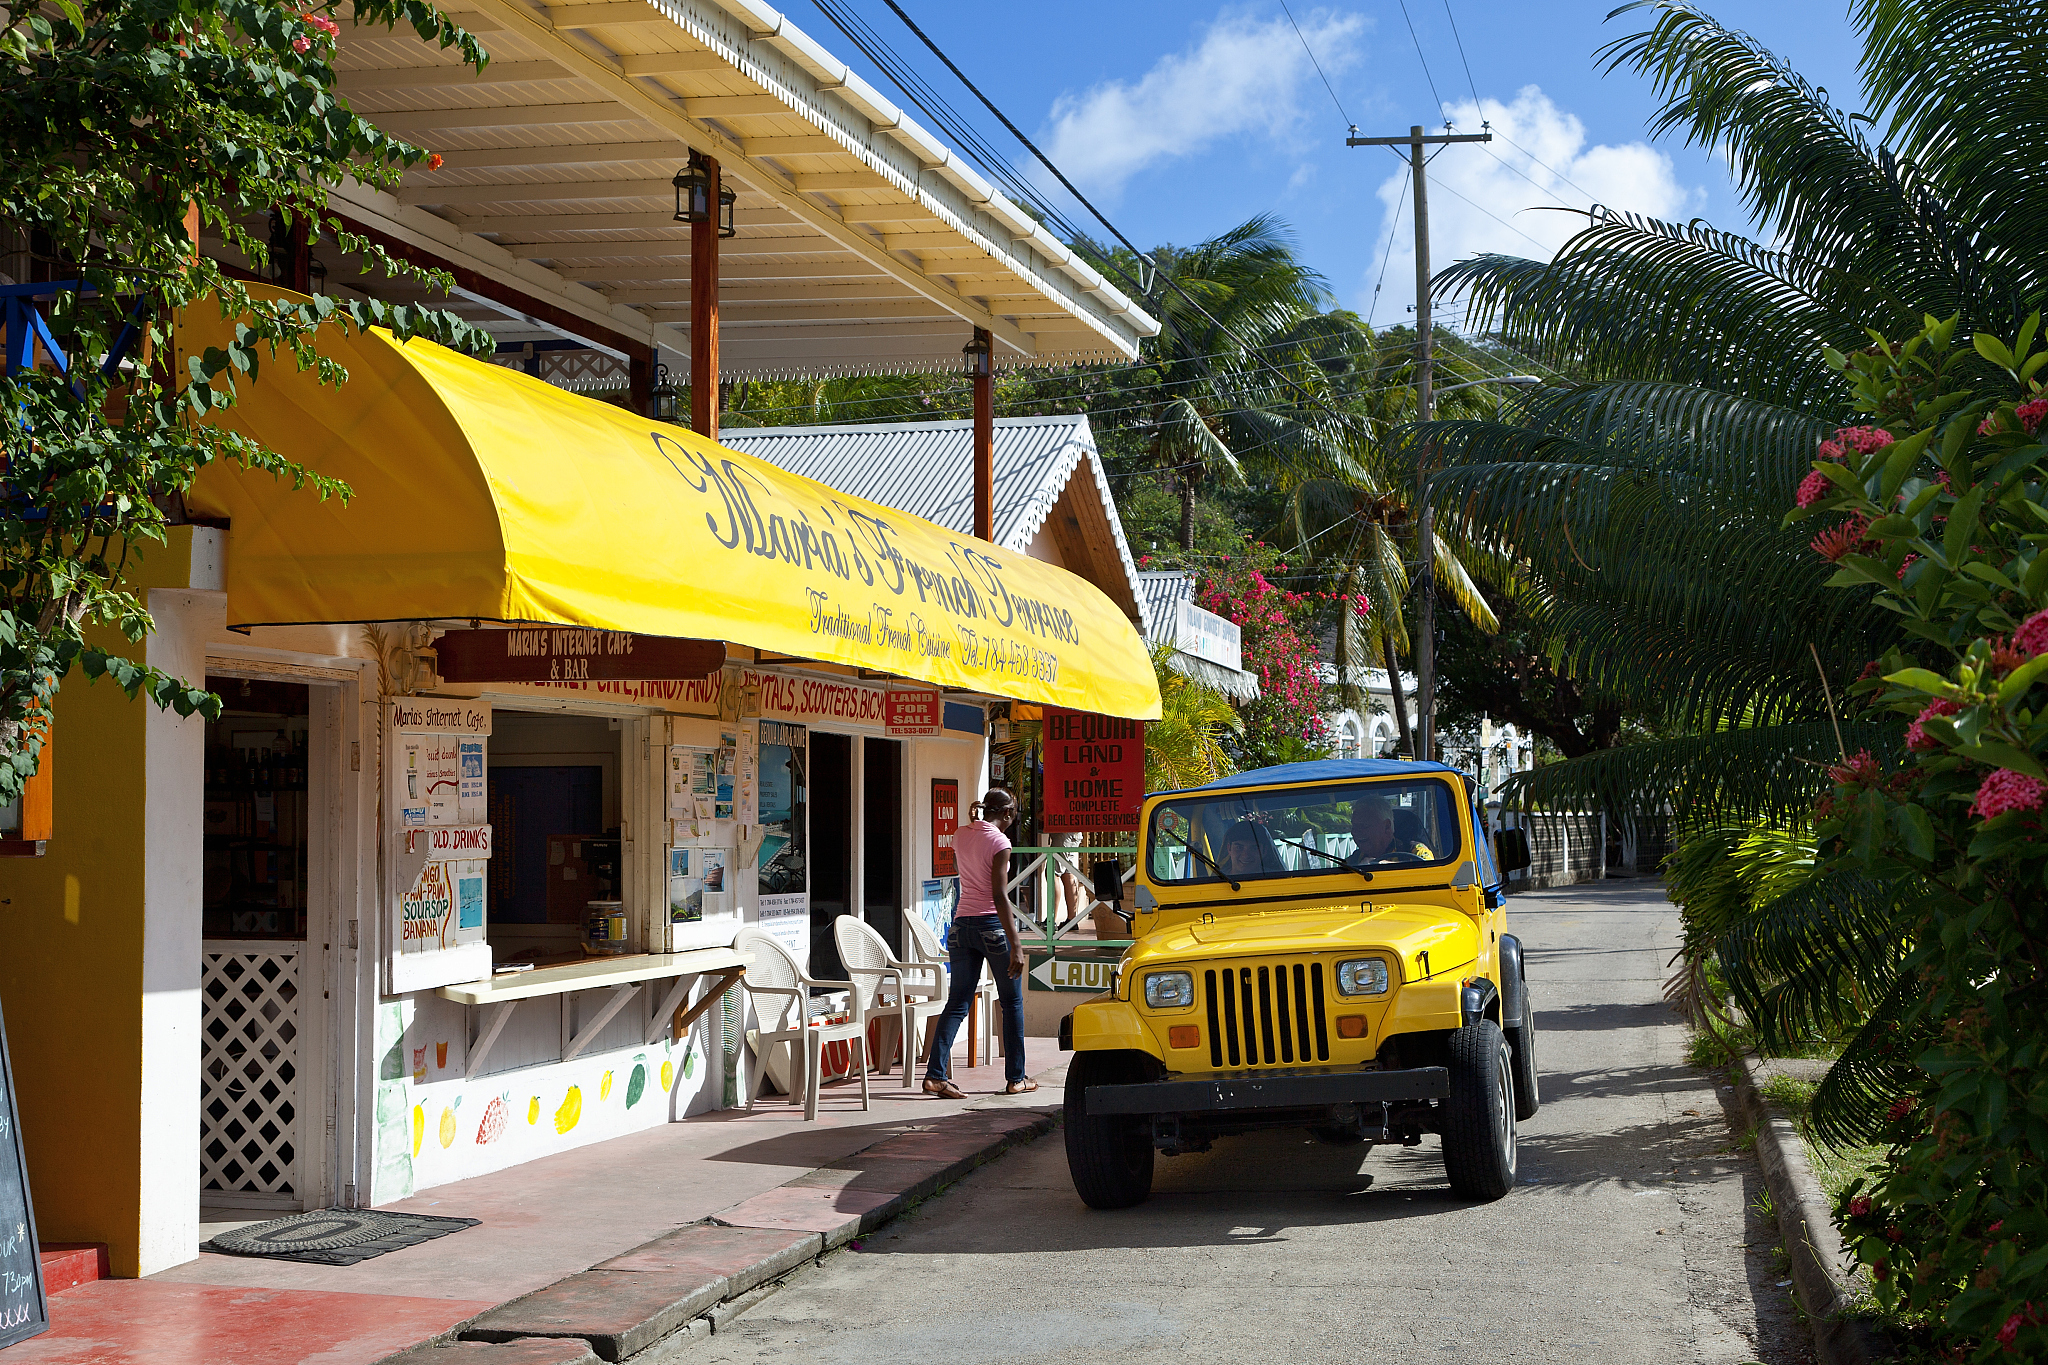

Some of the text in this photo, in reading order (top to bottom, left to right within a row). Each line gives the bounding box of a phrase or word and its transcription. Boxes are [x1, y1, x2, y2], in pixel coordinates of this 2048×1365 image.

[651, 432, 1079, 645] Maria's French Terrace
[507, 630, 633, 657] MARIA'S INTERNET CAFE
[806, 586, 872, 645] Traditional
[873, 602, 912, 652] French
[910, 611, 950, 658] Cuisine
[1008, 640, 1029, 676] 458
[1032, 647, 1058, 682] 3337
[550, 658, 590, 680] & BAR
[686, 669, 723, 703] ANDY
[890, 693, 933, 703] LAND
[426, 707, 462, 727] Internet
[896, 704, 928, 713] FOR
[892, 715, 932, 724] SALE
[1063, 744, 1123, 764] LAND
[1089, 766, 1100, 777] &
[935, 790, 957, 804] BEQUIA
[1064, 779, 1123, 799] HOME
[938, 806, 954, 819] LAND
[1069, 800, 1120, 812] COMPLETE
[1048, 813, 1141, 826] REAL ESTATE SERVICES
[433, 829, 452, 849] OLD,
[421, 865, 440, 883] NGO
[404, 898, 449, 920] SOURSOP
[403, 919, 439, 940] BANANA
